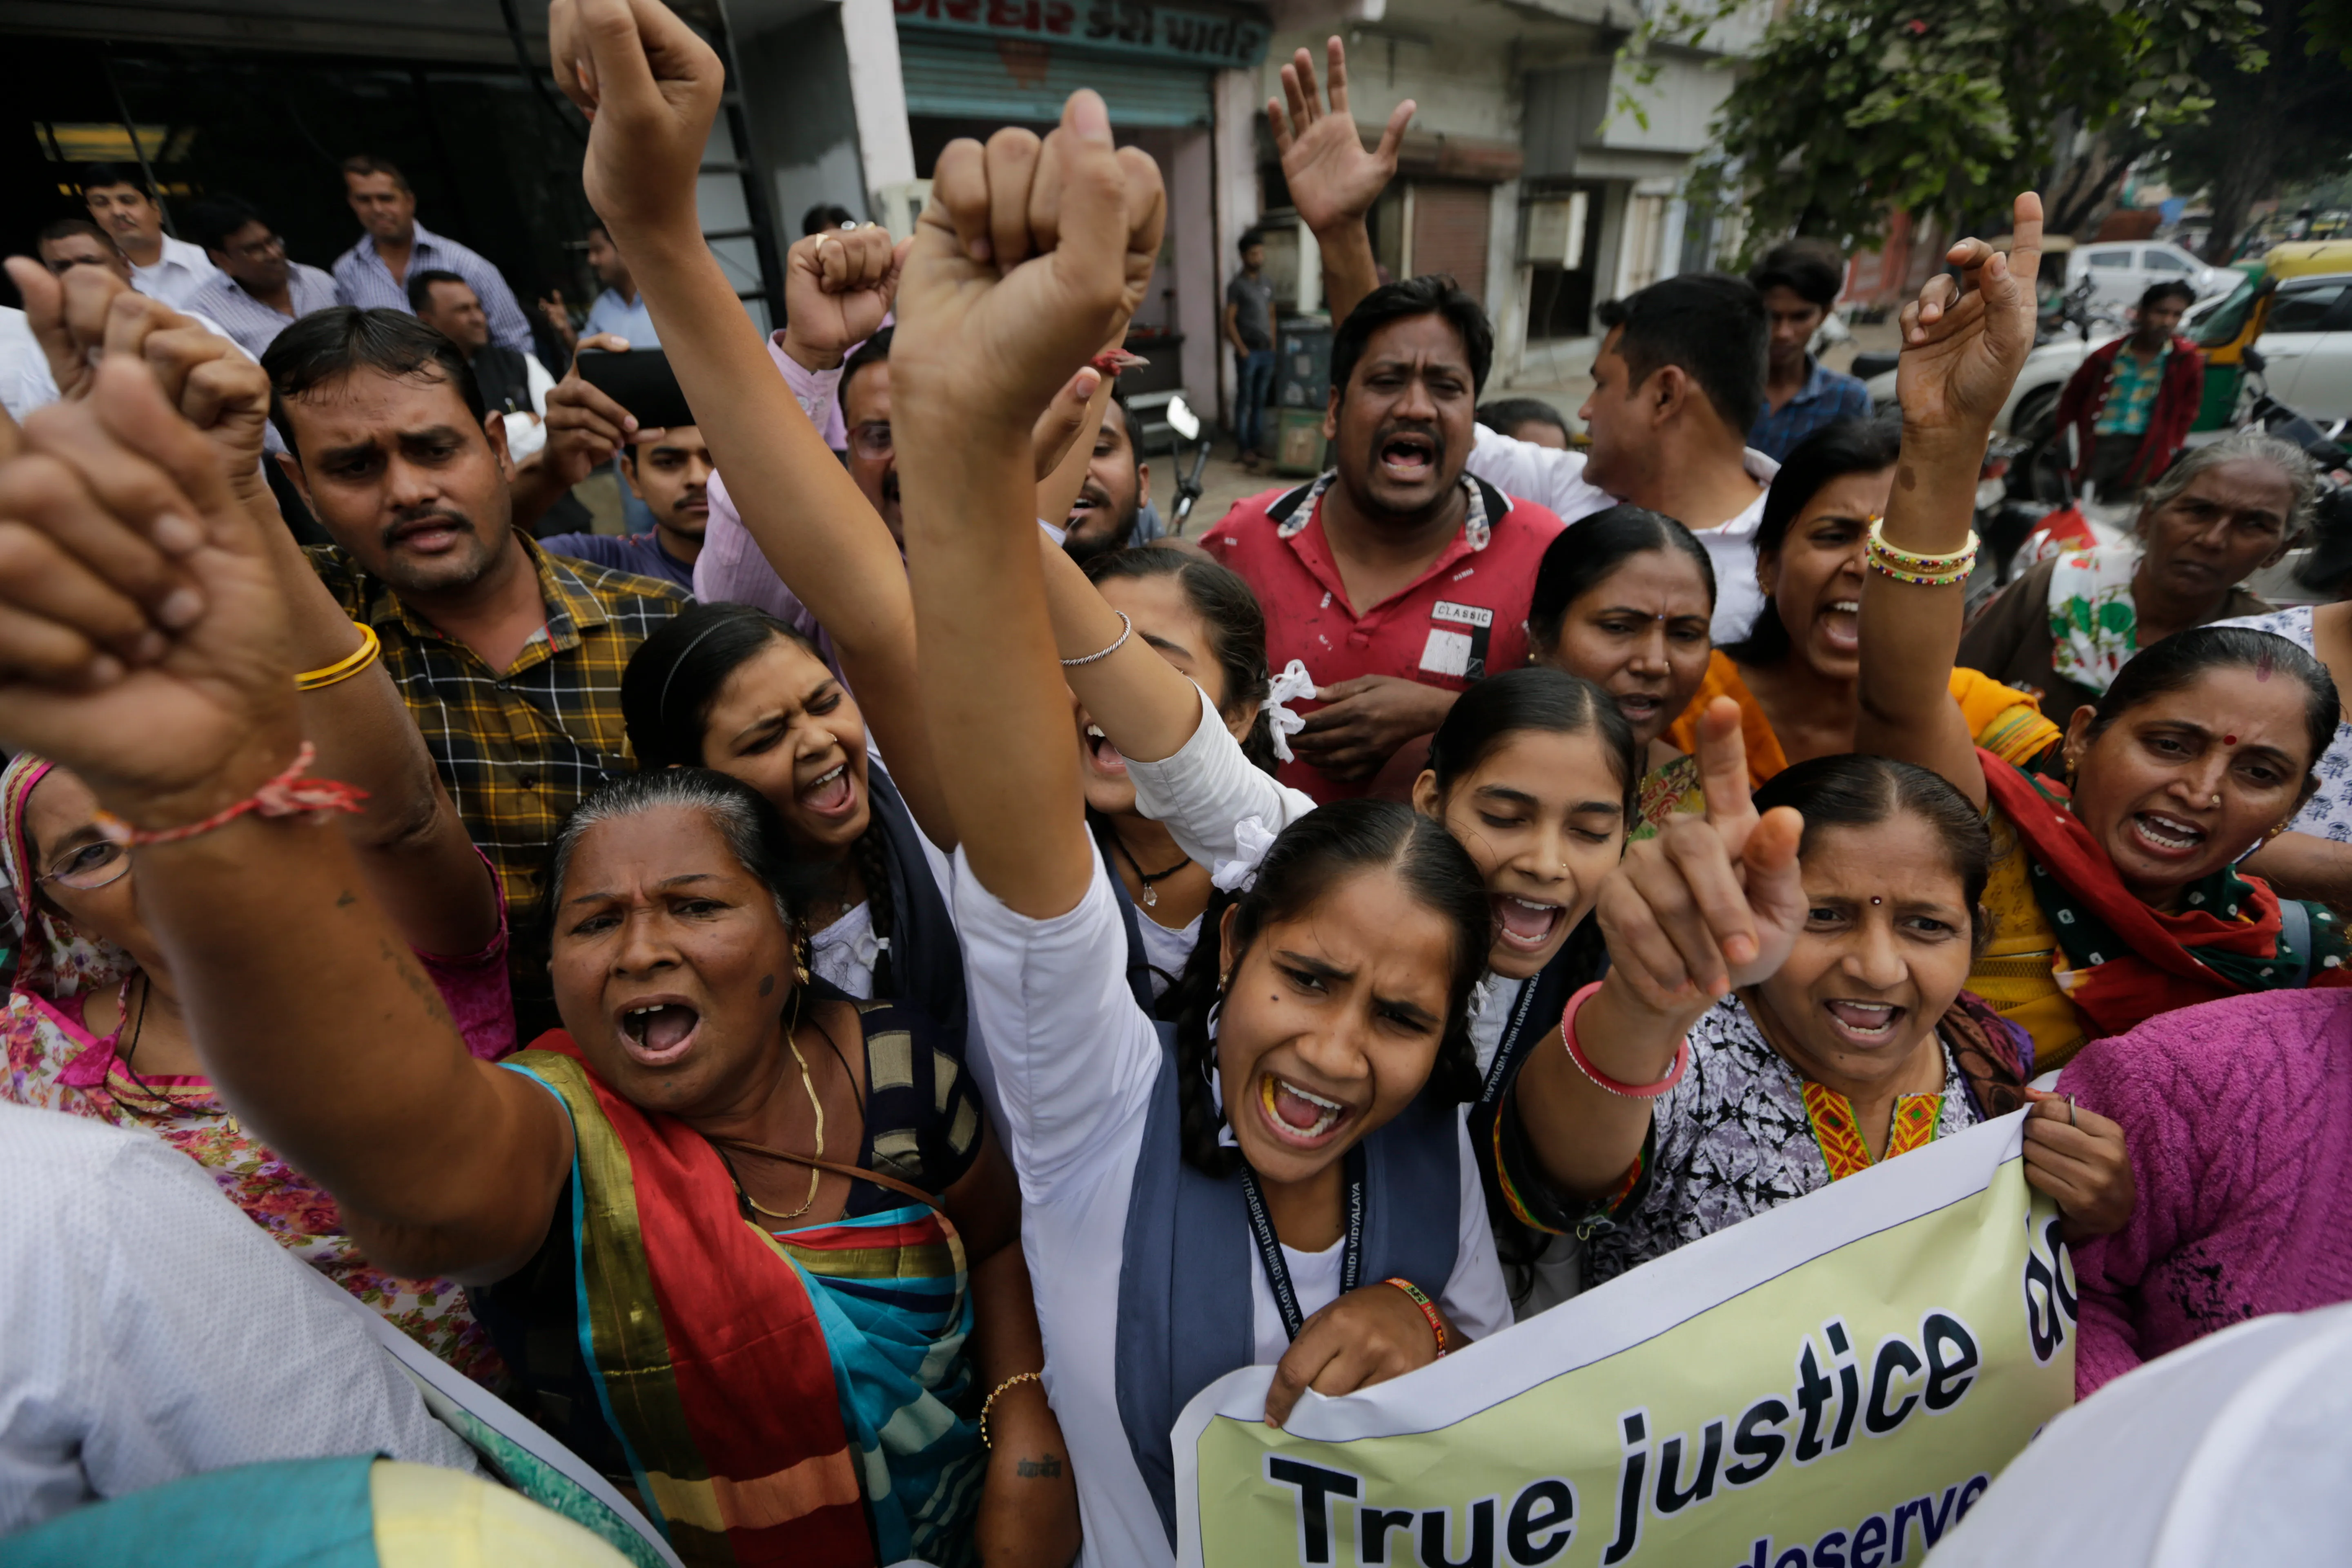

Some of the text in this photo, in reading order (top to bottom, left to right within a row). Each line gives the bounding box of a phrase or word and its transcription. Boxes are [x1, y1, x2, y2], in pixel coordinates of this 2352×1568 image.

[1437, 605, 1488, 623] CLASSIC
[1482, 970, 1541, 1102] TRABHARTI HINDI VIDYALAYA
[1241, 1166, 1301, 1336] SHTRABHARTI HINDI VIDYALAY
[1346, 1182, 1360, 1287] HINDI VIDYALAYA
[1270, 1457, 1574, 1568] True
[1604, 1314, 1978, 1565] justice
